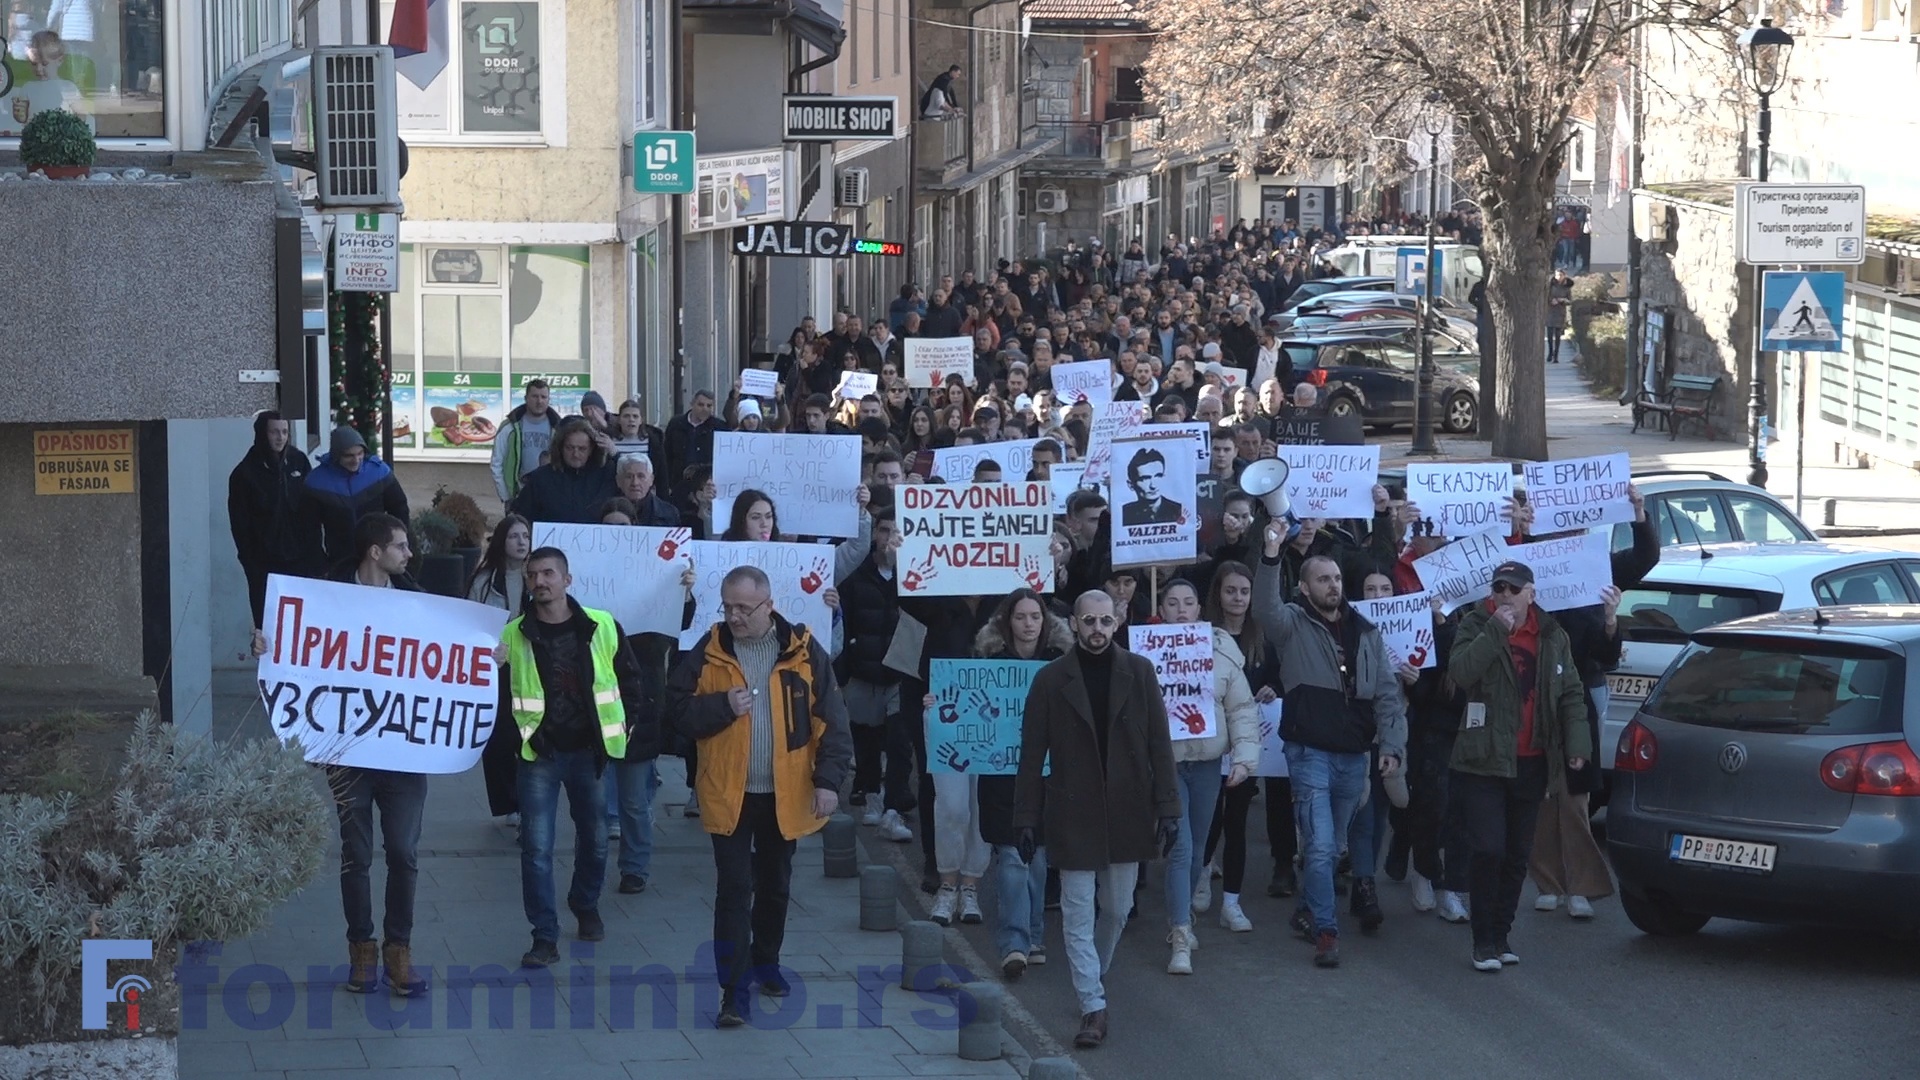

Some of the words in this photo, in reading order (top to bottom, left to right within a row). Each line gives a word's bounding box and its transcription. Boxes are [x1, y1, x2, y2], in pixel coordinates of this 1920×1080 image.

[485, 58, 518, 67] DDOR
[789, 106, 846, 130] MOBILE
[849, 107, 892, 130] SHOP
[651, 173, 678, 181] DDOR
[1752, 191, 1800, 204] Туристичка
[1803, 190, 1859, 203] организација
[1782, 204, 1828, 216] Пријепоље
[1757, 222, 1790, 232] Tourism
[1792, 222, 1842, 235] organization
[1844, 222, 1853, 232] of
[340, 239, 394, 248] ИНФО
[1785, 236, 1823, 248] Prijepolje
[346, 268, 387, 276] INFO
[453, 374, 471, 385] SA
[1276, 420, 1320, 436] ВАШЕ
[38, 434, 128, 452] OPASNOST
[718, 437, 757, 455] НАС
[772, 438, 793, 456] НЕ
[807, 440, 854, 459] МОГУ
[39, 458, 109, 474] OBRUŠAVA
[114, 460, 129, 472] SE
[744, 459, 770, 479] ДА
[785, 460, 828, 482] КУПЕ
[1290, 454, 1372, 472] ШКОЛСКИ
[1312, 471, 1333, 483] ЧАС
[1525, 466, 1544, 486] НЕ
[1554, 460, 1612, 484] БРИНИ
[60, 477, 110, 490] FASADA
[1416, 471, 1508, 493] ЧЕКАЈУЋИ
[904, 483, 1046, 509] ODZVONILO!
[1290, 486, 1299, 497] У
[1528, 489, 1580, 508] НЕЋЕШ
[1308, 499, 1328, 511] ЧАС
[903, 513, 975, 538] DAJTE
[982, 512, 1049, 537] ŠANSU
[1554, 507, 1603, 528] ОТКАЗ!
[1128, 525, 1177, 538] VALTER
[536, 527, 650, 556] ИСКЉУЧИ
[1116, 539, 1141, 547] BRANI
[1142, 535, 1188, 545] PRIJEPOLJE
[927, 542, 1020, 568] MOZGU
[1460, 533, 1499, 568] НА
[1538, 561, 1573, 579] ДАКЛЕ
[1376, 618, 1412, 635] АМИ
[1160, 652, 1177, 661] ЛИ
[1166, 658, 1213, 676] ГЛАСНО
[958, 666, 1028, 690] ОДРАСЛИ
[1160, 682, 1202, 697] УТИМ
[259, 680, 301, 728] УЗ
[305, 685, 493, 749] СТУДЕНТЕ
[1682, 839, 1703, 858] PP
